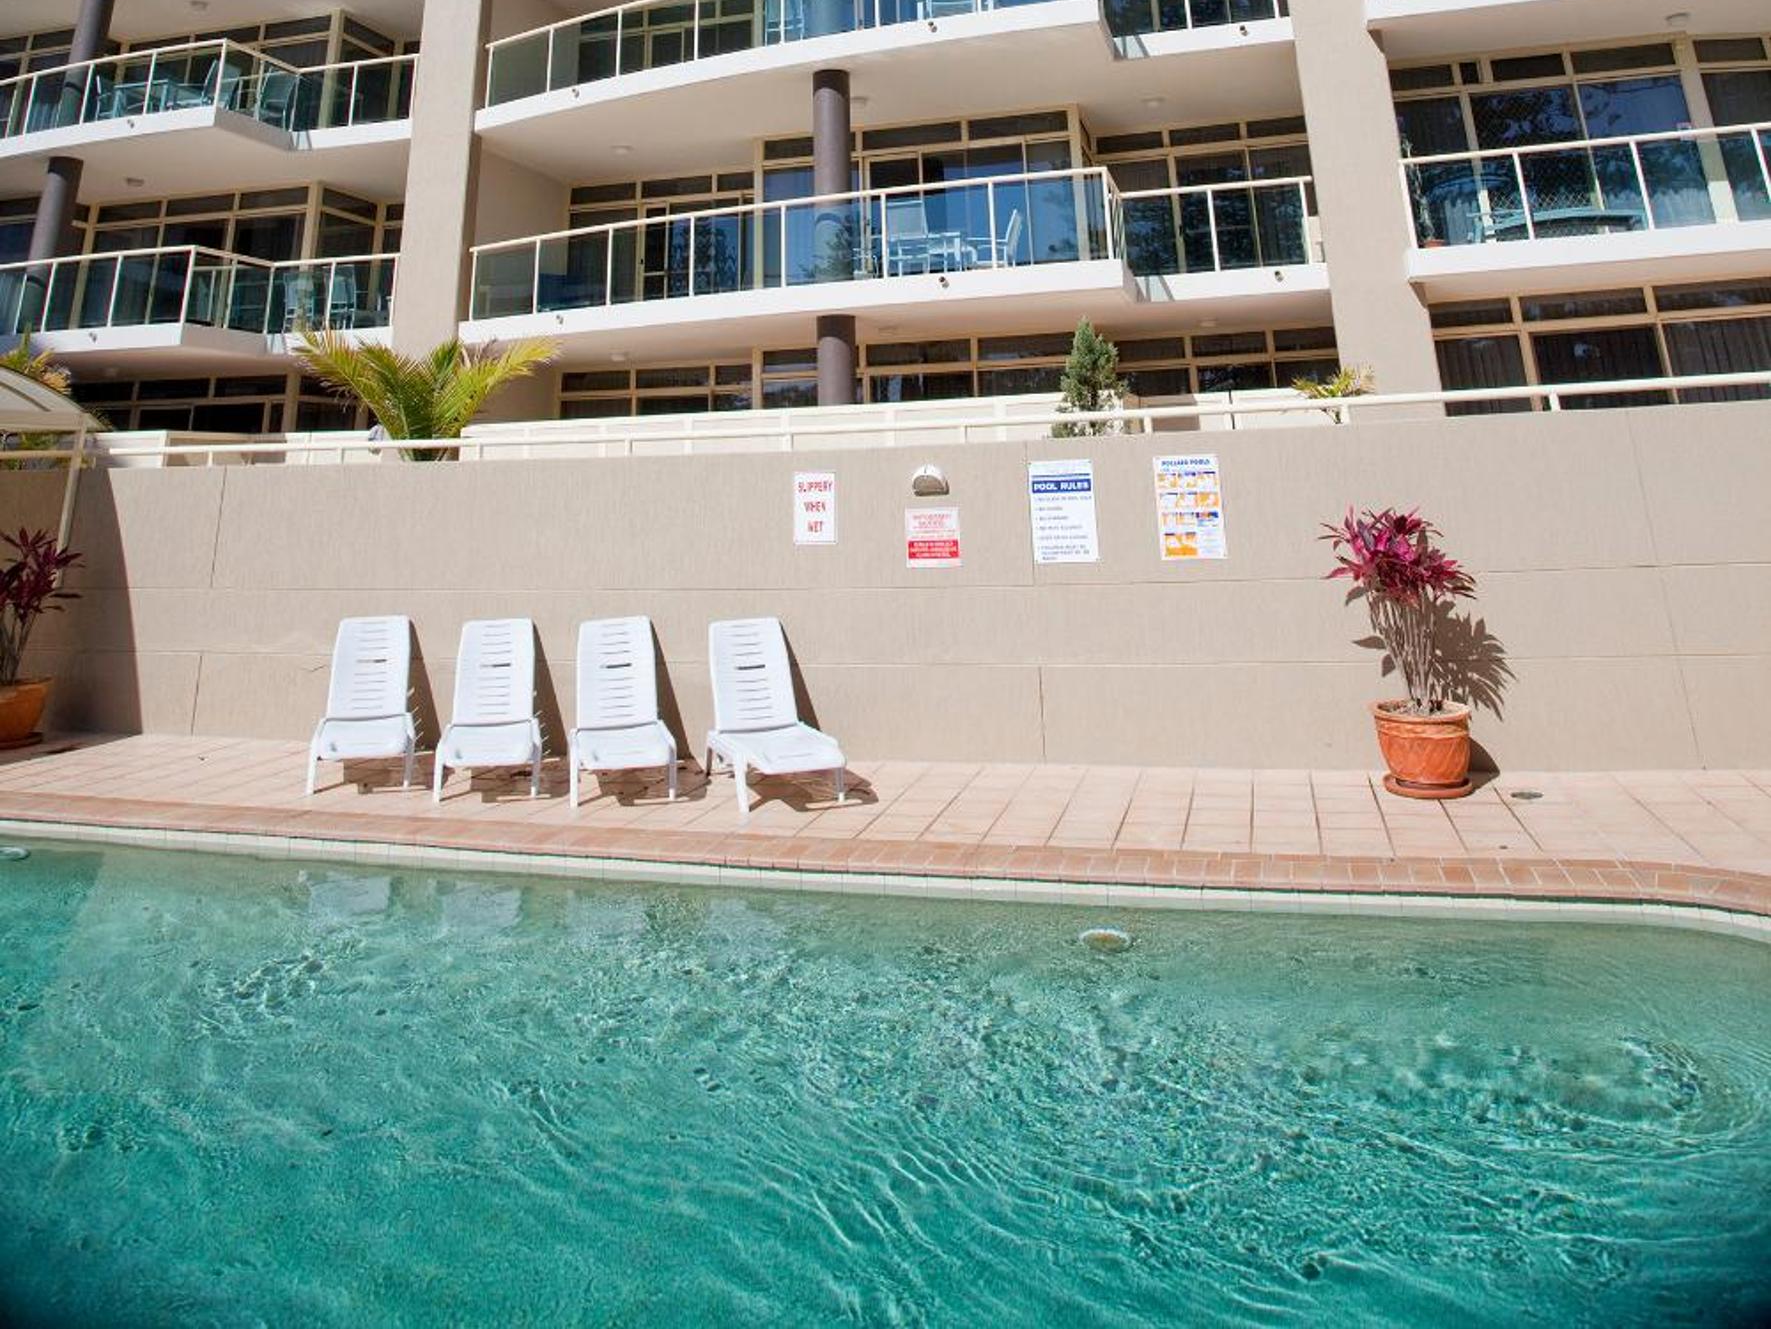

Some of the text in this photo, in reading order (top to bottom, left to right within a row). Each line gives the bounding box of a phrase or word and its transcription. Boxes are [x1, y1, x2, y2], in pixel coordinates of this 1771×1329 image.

[798, 480, 833, 493] SLIPPERY
[1034, 481, 1089, 491] POOL RULES
[804, 501, 826, 513] WHEN
[807, 521, 823, 533] WET
